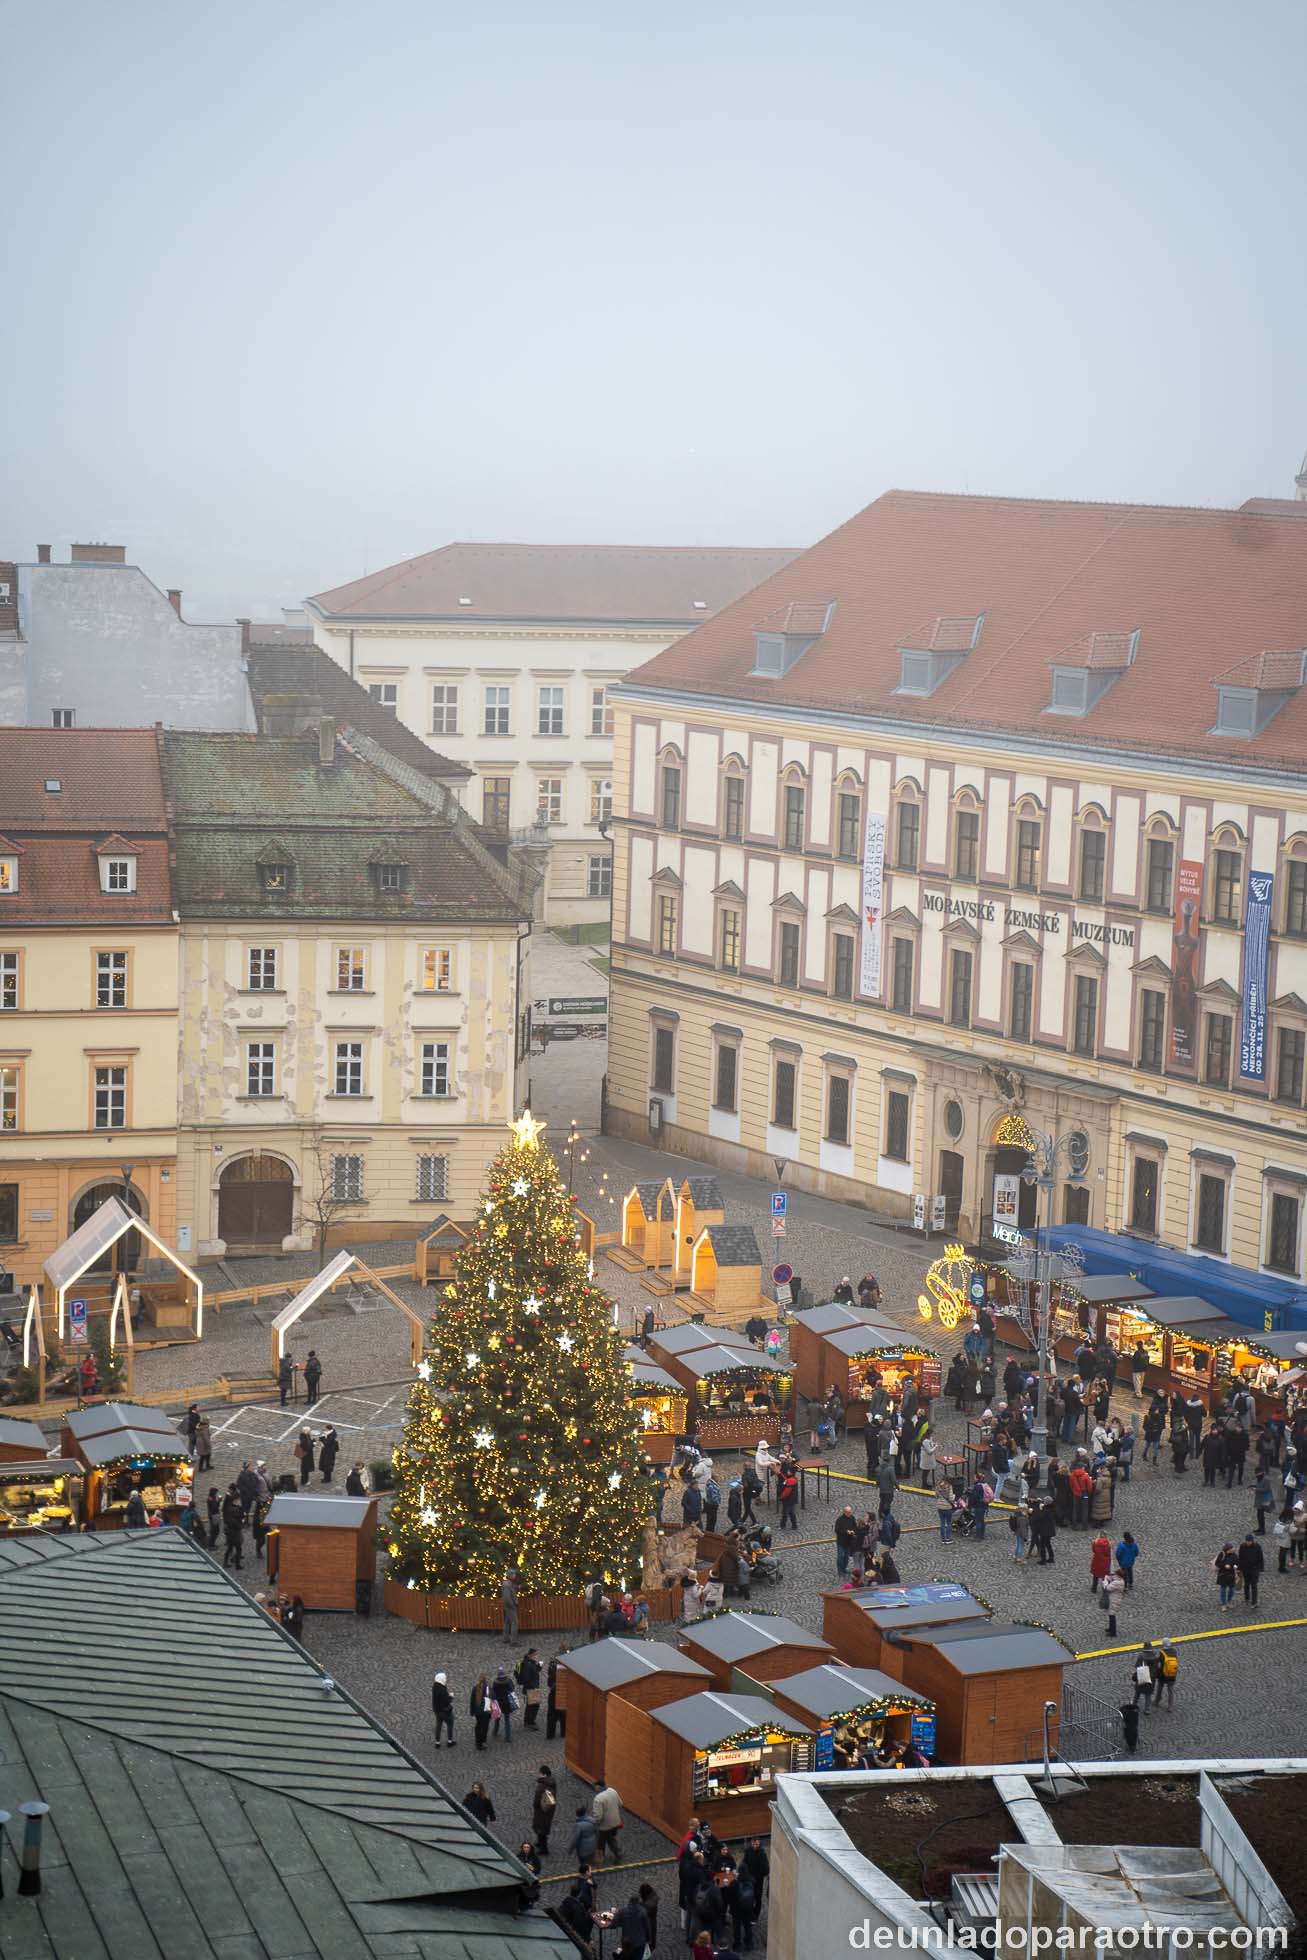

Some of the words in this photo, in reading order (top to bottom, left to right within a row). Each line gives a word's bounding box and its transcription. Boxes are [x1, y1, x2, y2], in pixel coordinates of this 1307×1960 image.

[872, 822, 884, 899] SVOBODY
[923, 894, 995, 921] MORAVSKÉ
[1004, 908, 1060, 934] ZEMSKÉ
[1072, 920, 1135, 947] MUZEUM
[1256, 1060, 1263, 1074] OD
[992, 1223, 1023, 1246] Merch
